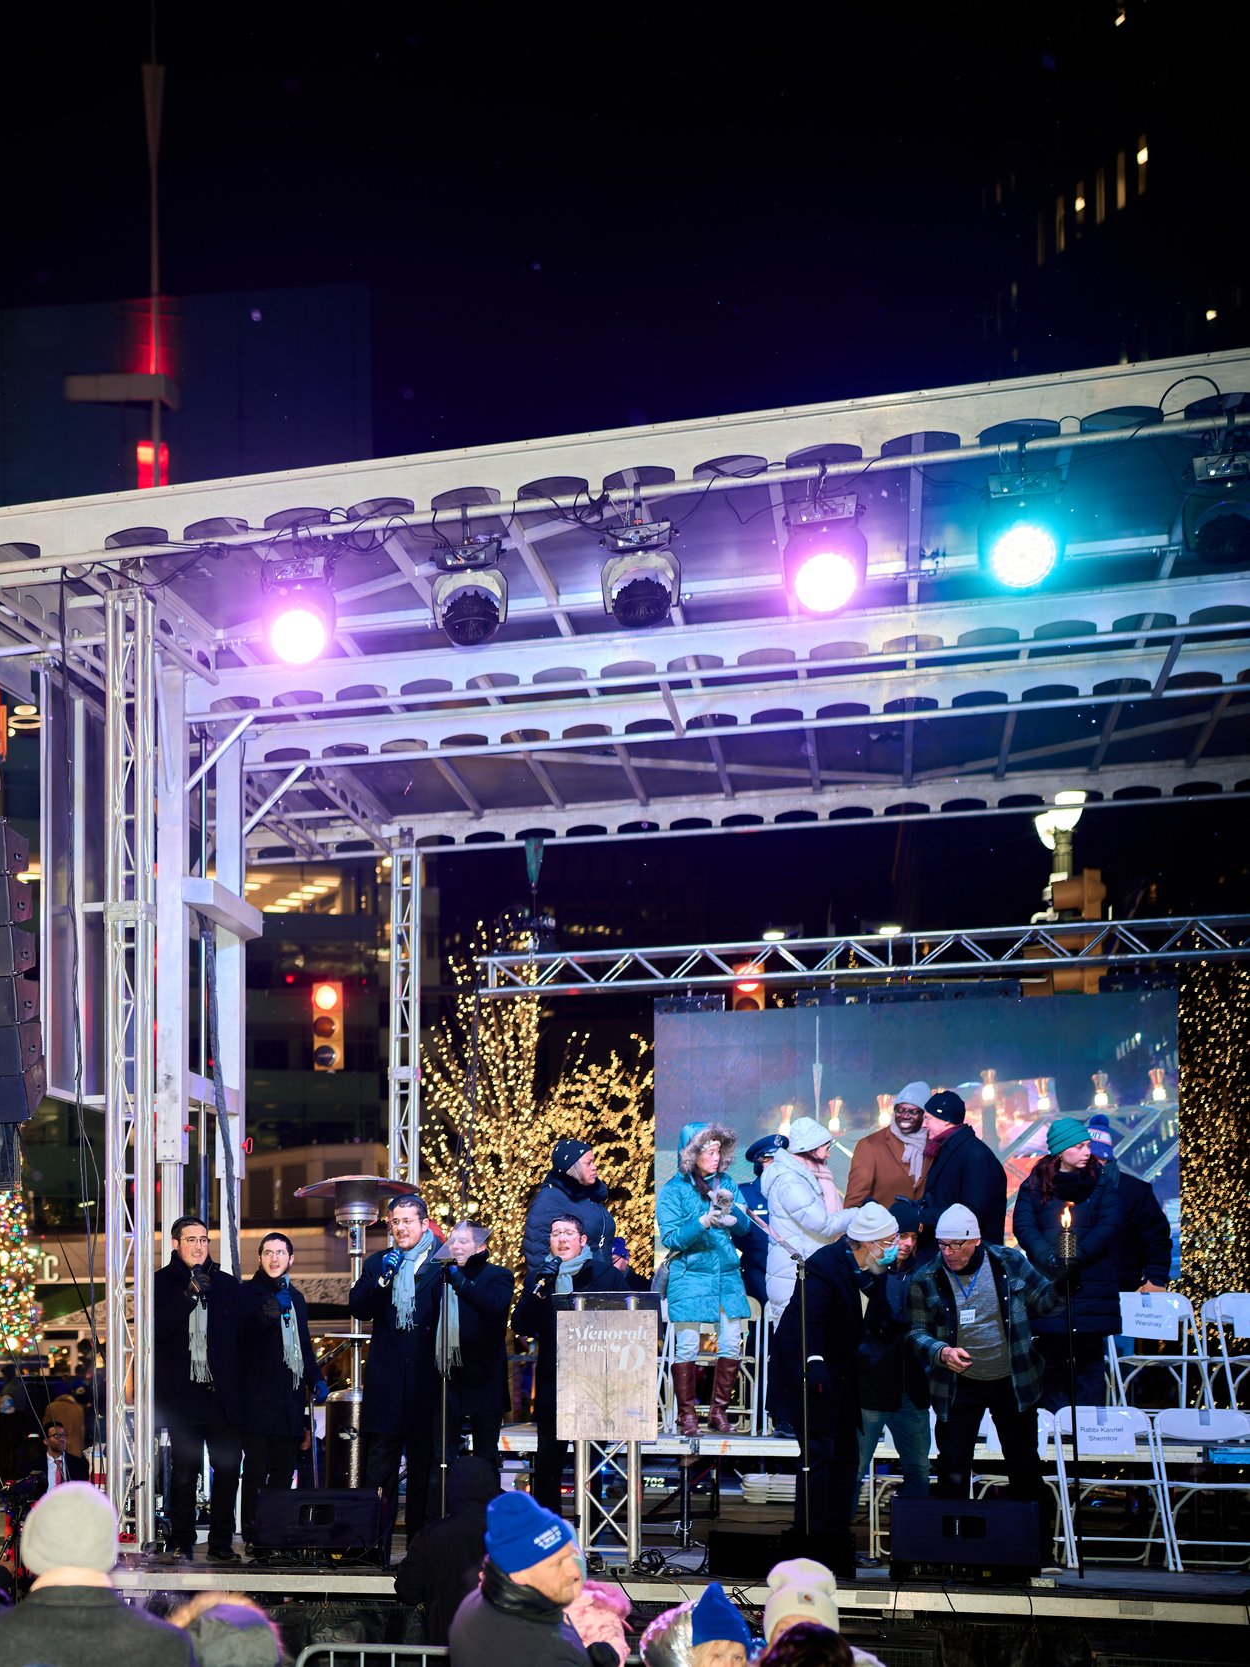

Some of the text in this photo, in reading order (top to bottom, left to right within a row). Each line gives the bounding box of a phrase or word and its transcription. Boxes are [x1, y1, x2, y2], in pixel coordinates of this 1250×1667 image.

[1135, 1319, 1162, 1328] Warshay
[566, 1325, 647, 1341] Menorah
[577, 1342, 587, 1353] in
[590, 1342, 607, 1353] the
[643, 1477, 665, 1488] 702
